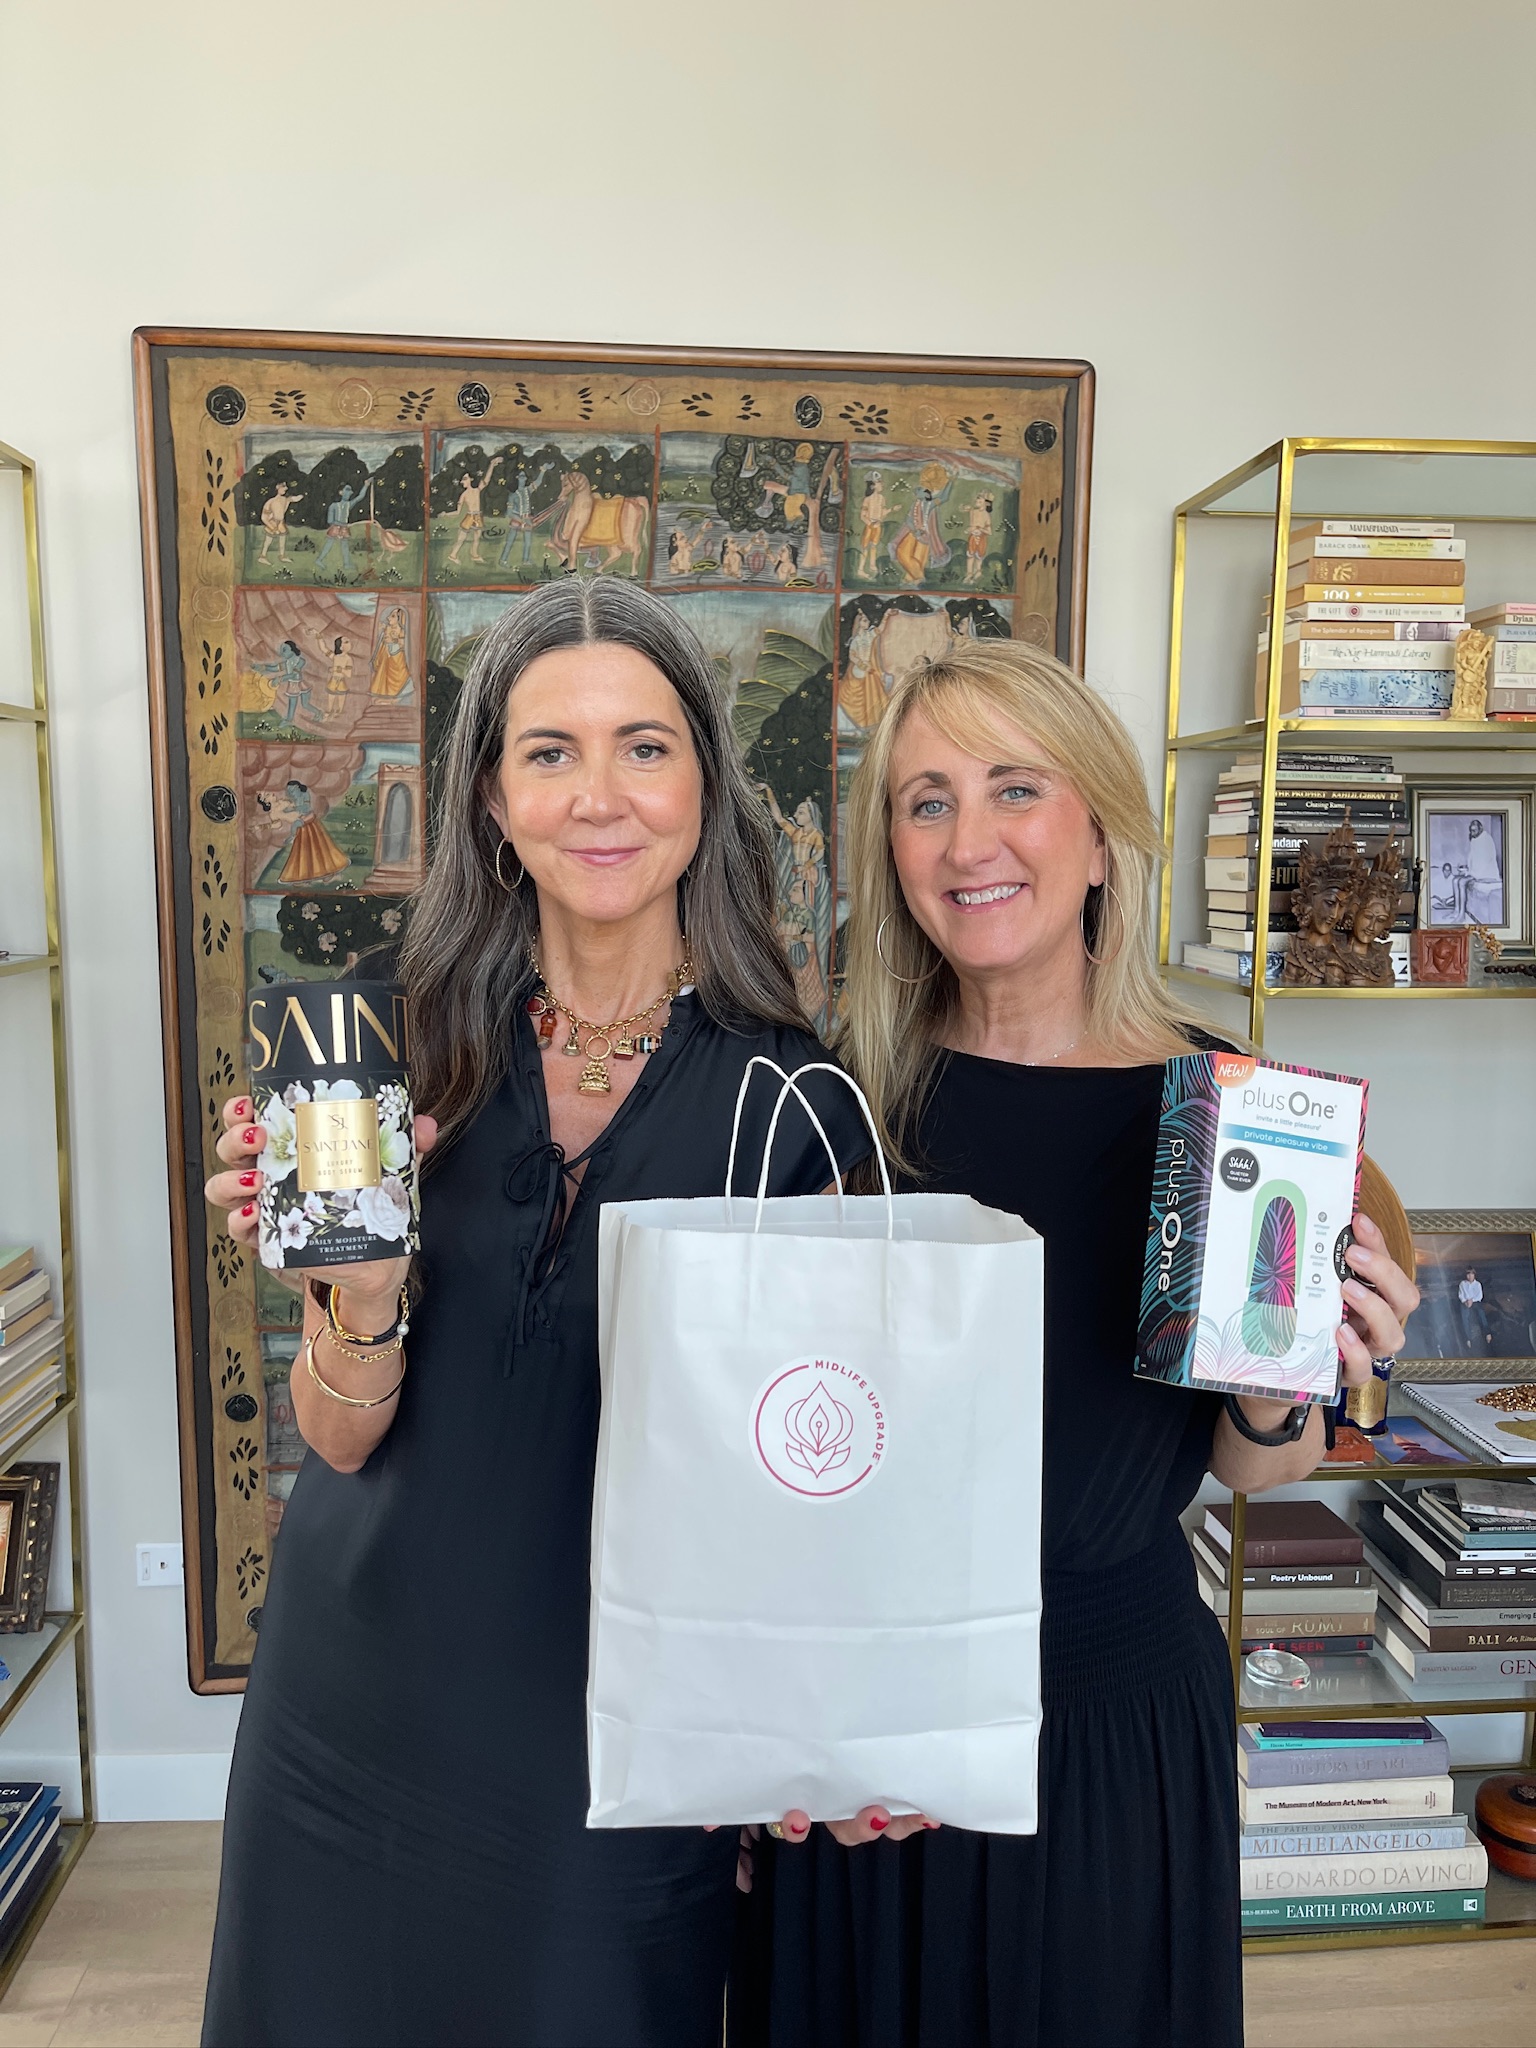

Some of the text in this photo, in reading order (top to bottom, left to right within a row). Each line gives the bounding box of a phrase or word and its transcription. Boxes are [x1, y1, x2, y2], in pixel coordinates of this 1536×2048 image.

[1322, 589, 1350, 600] 100
[1512, 615, 1534, 624] Dylan
[1322, 627, 1348, 635] Splendor
[1356, 628, 1390, 636] Recognition
[1402, 648, 1432, 661] Library
[1320, 675, 1329, 691] The
[1329, 681, 1339, 698] Tale
[1305, 801, 1329, 810] Chasing
[1218, 1063, 1250, 1078] NEW!
[1242, 1086, 1336, 1119] plusOne
[1256, 1114, 1273, 1123] invite
[1280, 1118, 1293, 1127] little
[303, 1138, 374, 1154] SAINT JANE
[1244, 1130, 1329, 1152] private pleasure vibe
[1228, 1156, 1254, 1170] Shhh!
[1158, 1139, 1187, 1292] plusOne
[309, 1235, 378, 1246] DAILY MOISTURE
[318, 1243, 369, 1254] TREATMENT
[815, 1360, 885, 1461] MIDLIFE UPGRADE
[1270, 1573, 1333, 1583] Poetry Unbound
[1499, 1612, 1532, 1620] Emerging
[1256, 1627, 1274, 1635] SOUL
[1291, 1618, 1343, 1636] RUMI
[1290, 1641, 1325, 1651] SEEN
[1468, 1634, 1500, 1645] BALI
[1506, 1635, 1519, 1643] Art,
[1289, 1758, 1406, 1775] HISTORY OF ART
[1261, 1826, 1282, 1834] THE
[1314, 1824, 1327, 1832] OF
[1333, 1823, 1365, 1831] VISION
[1253, 1833, 1432, 1854] MICHELANGELO
[1255, 1863, 1473, 1890] LEONARDO DA VINCI
[1286, 1902, 1336, 1918] EARTH
[1341, 1901, 1384, 1916] FROM
[1387, 1900, 1436, 1914] ABOVE
